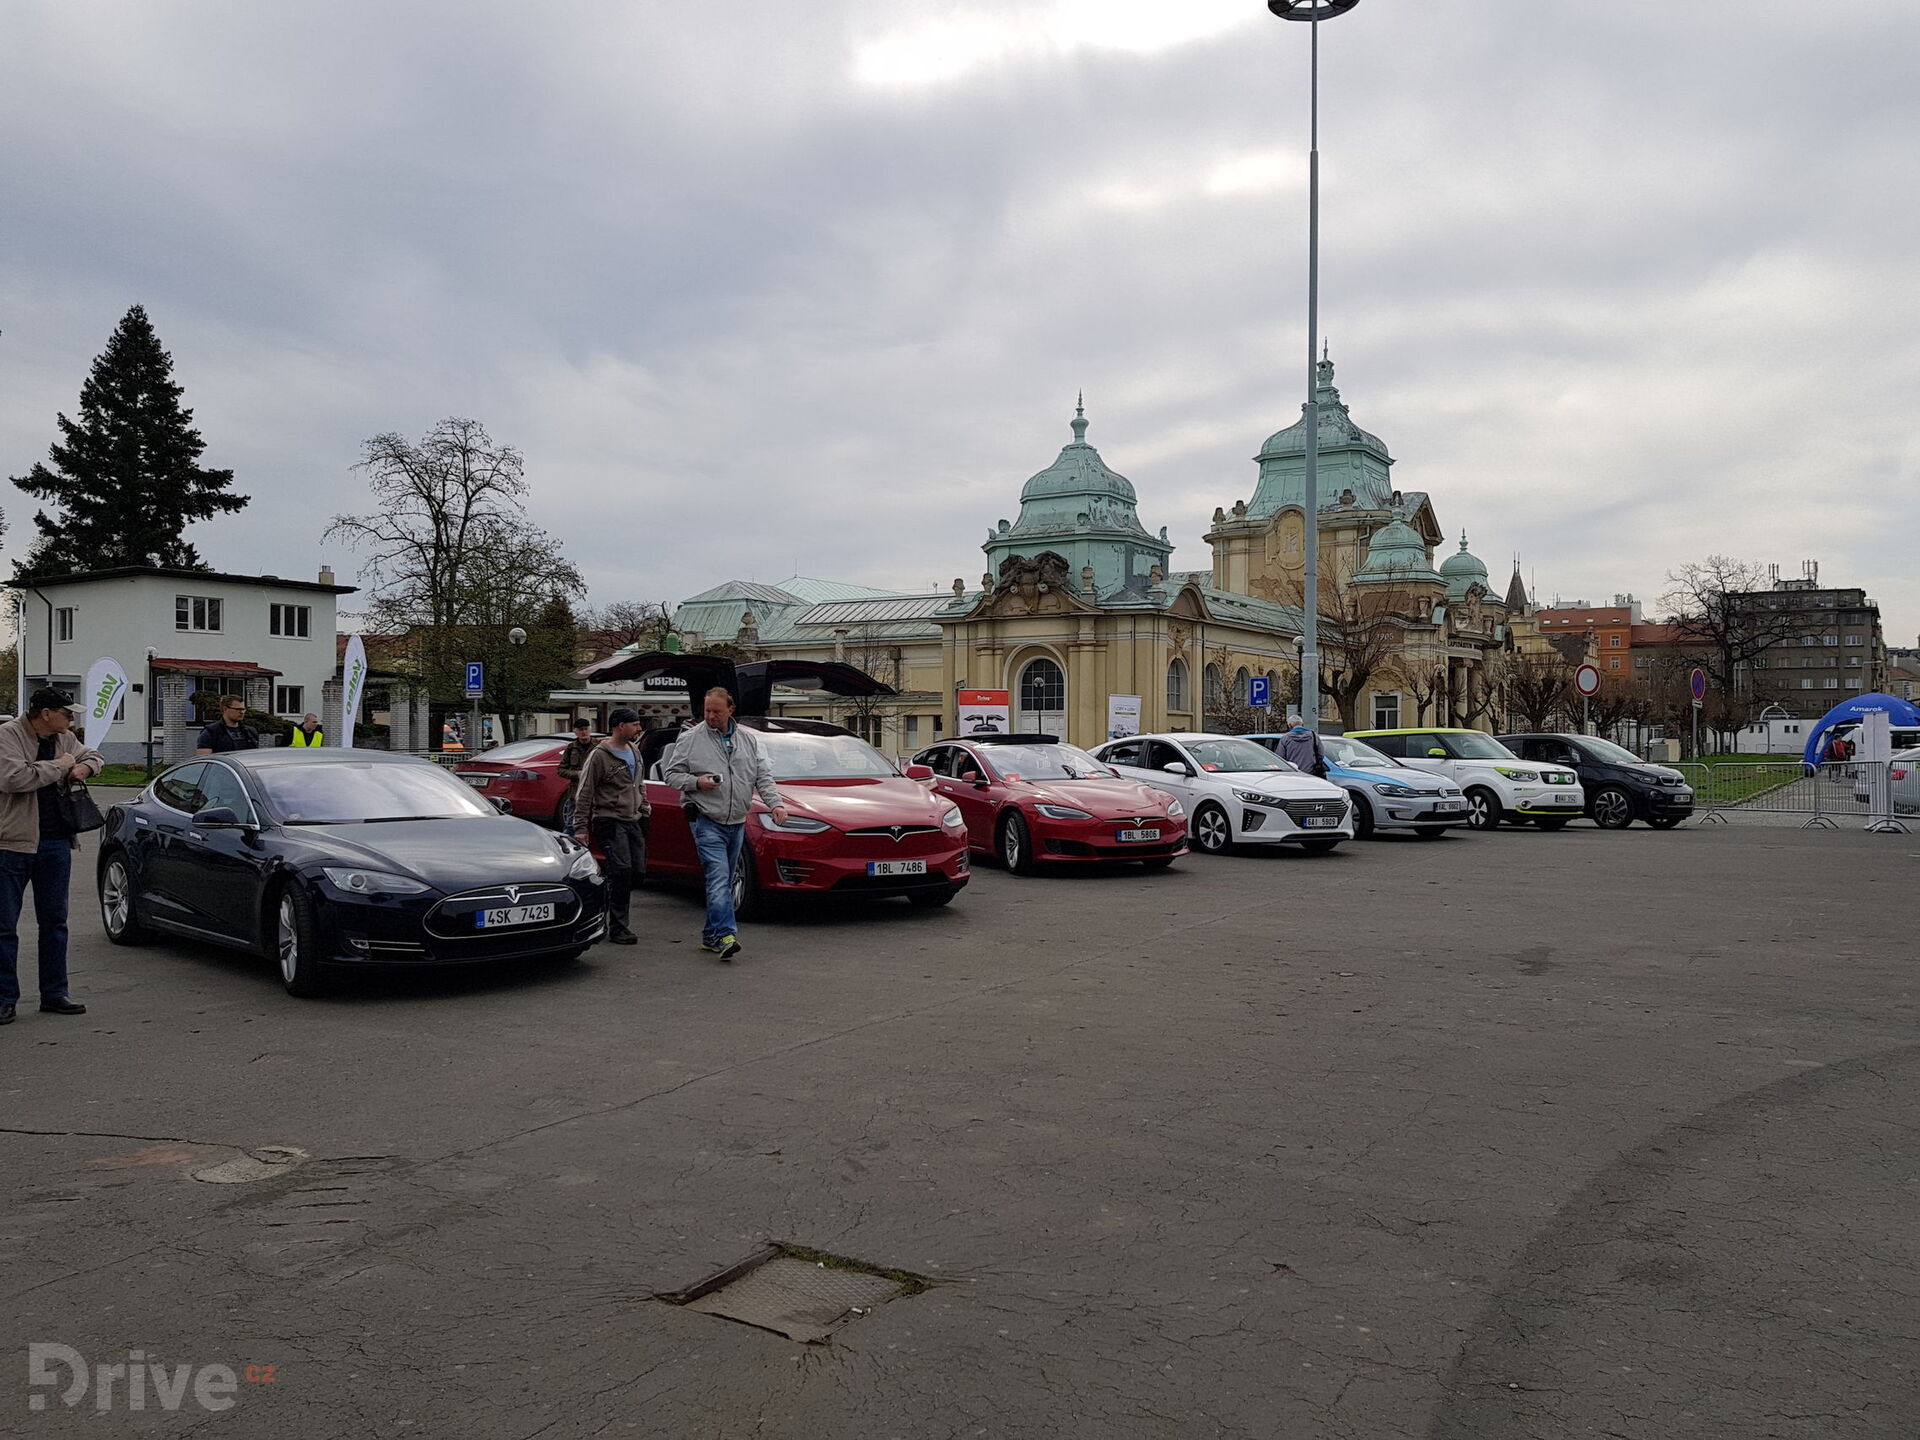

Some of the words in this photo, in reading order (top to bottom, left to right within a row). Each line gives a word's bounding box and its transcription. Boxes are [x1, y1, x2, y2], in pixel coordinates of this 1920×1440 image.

[469, 665, 479, 683] P
[1253, 680, 1265, 698] P
[1123, 831, 1136, 840] 1BL
[877, 863, 893, 874] 1BL
[900, 862, 923, 873] 7486
[487, 909, 512, 925] 4SK
[521, 905, 550, 921] 7429
